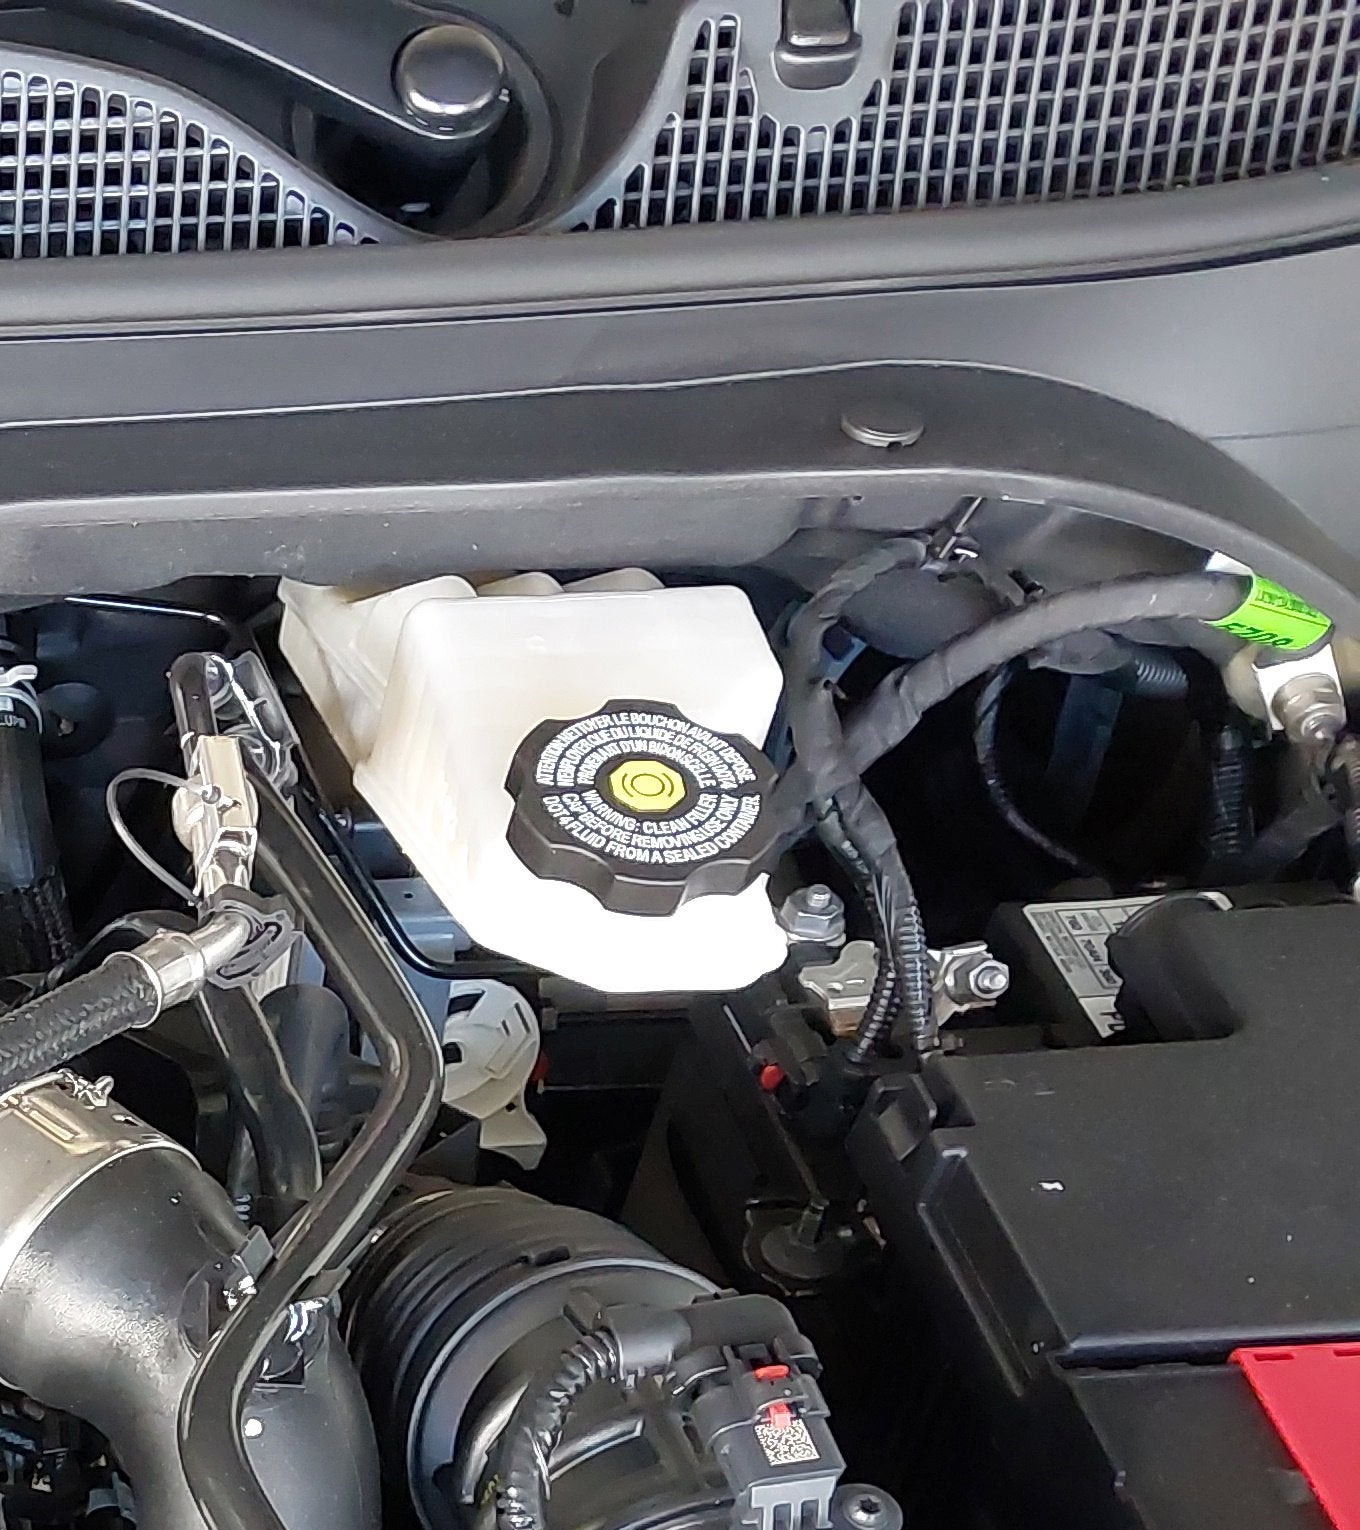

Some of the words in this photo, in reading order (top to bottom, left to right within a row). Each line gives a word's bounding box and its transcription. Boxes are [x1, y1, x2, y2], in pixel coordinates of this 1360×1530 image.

[612, 712, 630, 725] LE
[630, 712, 690, 733] BOUCHON
[686, 726, 729, 750] AVANT
[628, 726, 676, 742] LIQUIDE
[673, 735, 694, 749] DE
[649, 741, 686, 761] BIDON
[562, 793, 588, 814] CAP
[579, 812, 632, 844] BEFORE
[715, 794, 739, 820] ONLY
[581, 790, 640, 831] WARNING:
[643, 817, 692, 835] CLEAN
[685, 793, 718, 825] FILLER
[565, 821, 606, 848] FLUID
[605, 841, 650, 862] FROM
[651, 850, 663, 863] A
[663, 842, 720, 863] SEALED
